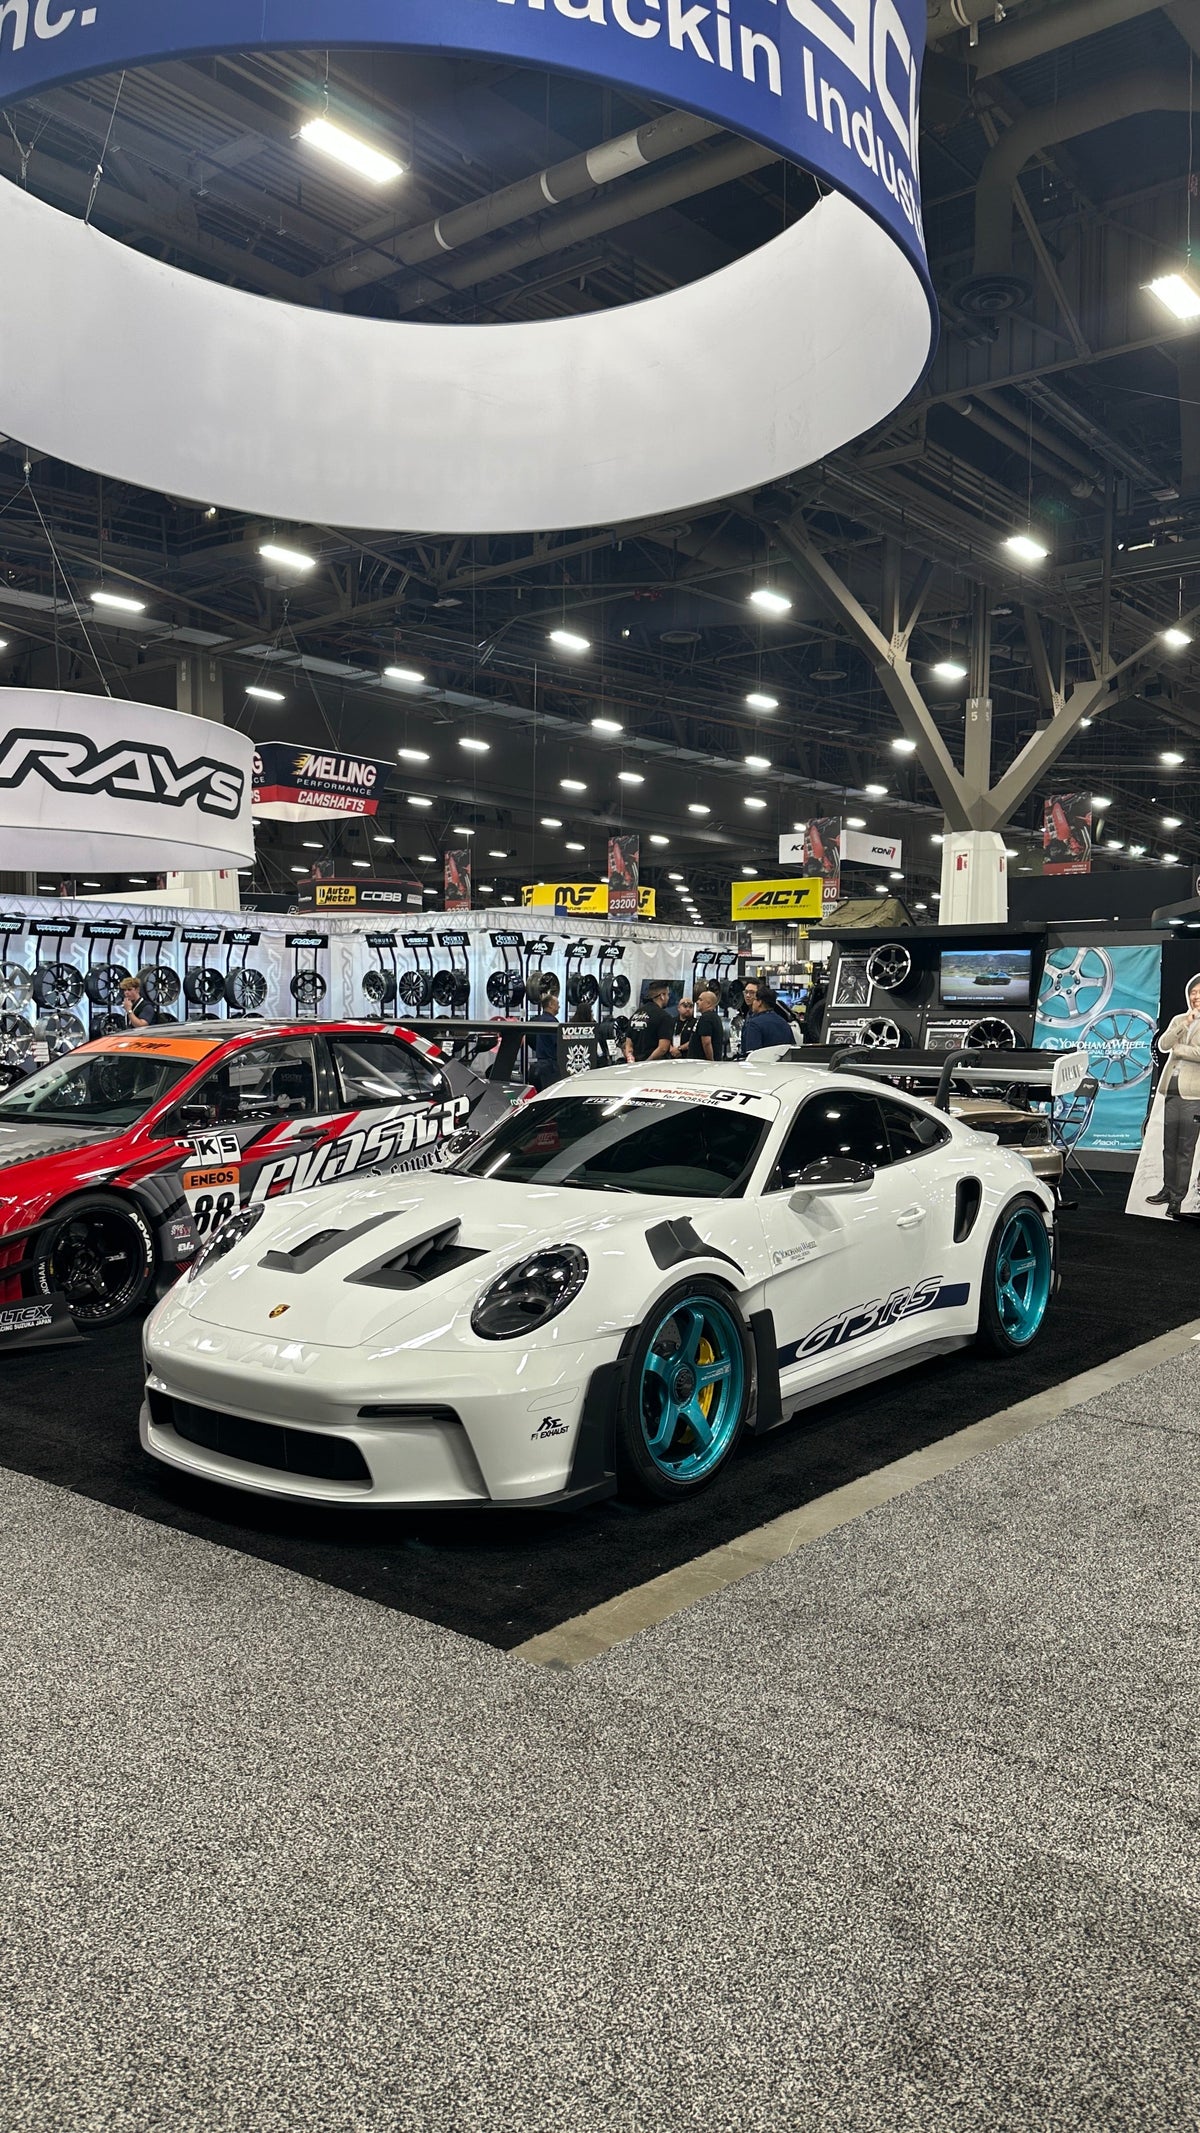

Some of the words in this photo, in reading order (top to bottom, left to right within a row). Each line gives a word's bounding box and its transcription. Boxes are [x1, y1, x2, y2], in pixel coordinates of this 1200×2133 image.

[971, 700, 979, 709] N
[971, 712, 978, 722] 5
[0, 733, 243, 815] RAYS
[300, 754, 377, 787] MELLING
[296, 778, 373, 796] PERFORMANCE
[297, 790, 366, 812] CAMSHAFTS
[326, 895, 355, 903] Meter
[327, 887, 350, 895] Auto
[361, 891, 402, 902] COBB
[753, 889, 810, 907] ACT
[610, 899, 636, 910] 23200
[562, 1026, 595, 1035] VOLTEX
[677, 1096, 720, 1106] PORSCHE
[711, 1089, 762, 1106] GT
[191, 1171, 234, 1187] ENEOS
[193, 1192, 235, 1234] 88
[128, 1212, 153, 1263] ADVAN
[180, 1327, 320, 1376] ADVAN
[540, 1425, 570, 1439] EXHAUST
